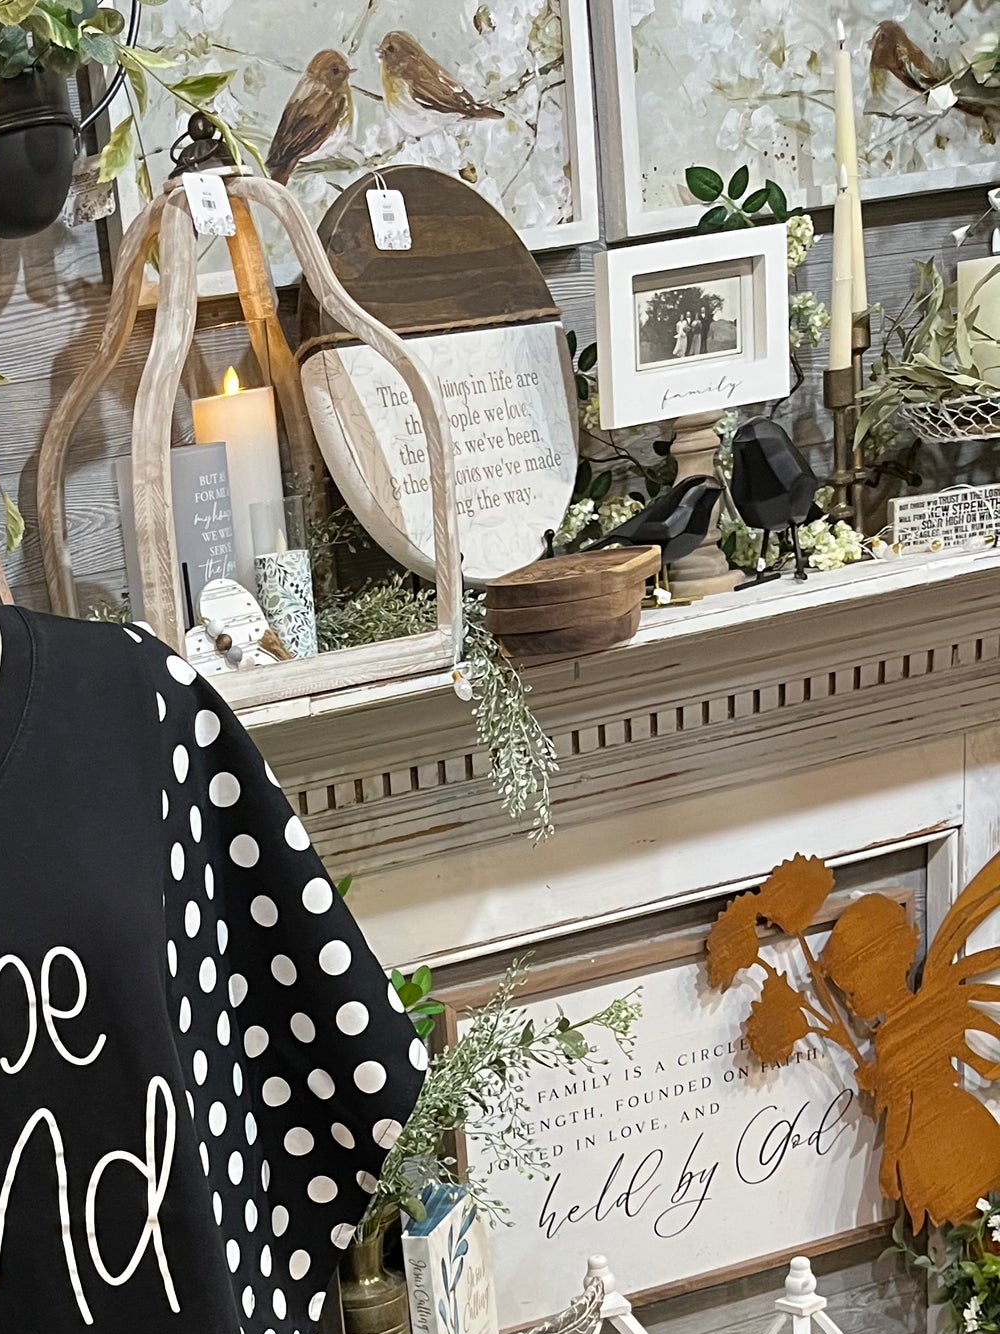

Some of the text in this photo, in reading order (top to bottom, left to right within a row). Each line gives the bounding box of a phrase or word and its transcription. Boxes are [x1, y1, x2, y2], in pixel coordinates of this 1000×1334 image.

[376, 370, 539, 408] The hings in life are
[661, 375, 743, 410] family
[405, 414, 423, 435] th
[449, 405, 480, 432] ople
[484, 406, 504, 422] we
[400, 444, 425, 466] the
[465, 432, 504, 454] we've
[199, 473, 218, 487] BUT
[390, 476, 402, 501] &
[403, 473, 429, 495] the
[483, 458, 521, 480] we've
[525, 448, 562, 472] made
[194, 491, 215, 503] FOR
[477, 489, 500, 511] the
[504, 487, 537, 508] way.
[938, 493, 959, 505] TRUST
[194, 513, 212, 530] my
[201, 530, 218, 542] WE
[921, 518, 943, 530] SOAR
[945, 514, 964, 526] HIGH
[198, 558, 221, 582] the
[538, 1073, 612, 1104] FAMILY
[625, 1066, 642, 1081] IS
[655, 1061, 665, 1073] A
[677, 1038, 749, 1067] CIRCLE
[615, 1076, 712, 1112] FOUNDED
[723, 1066, 749, 1083] ON
[487, 1102, 721, 1175] JOINED IN LOVE, AND
[538, 1088, 855, 1239] held by God
[408, 1258, 432, 1334] Jesus Calling
